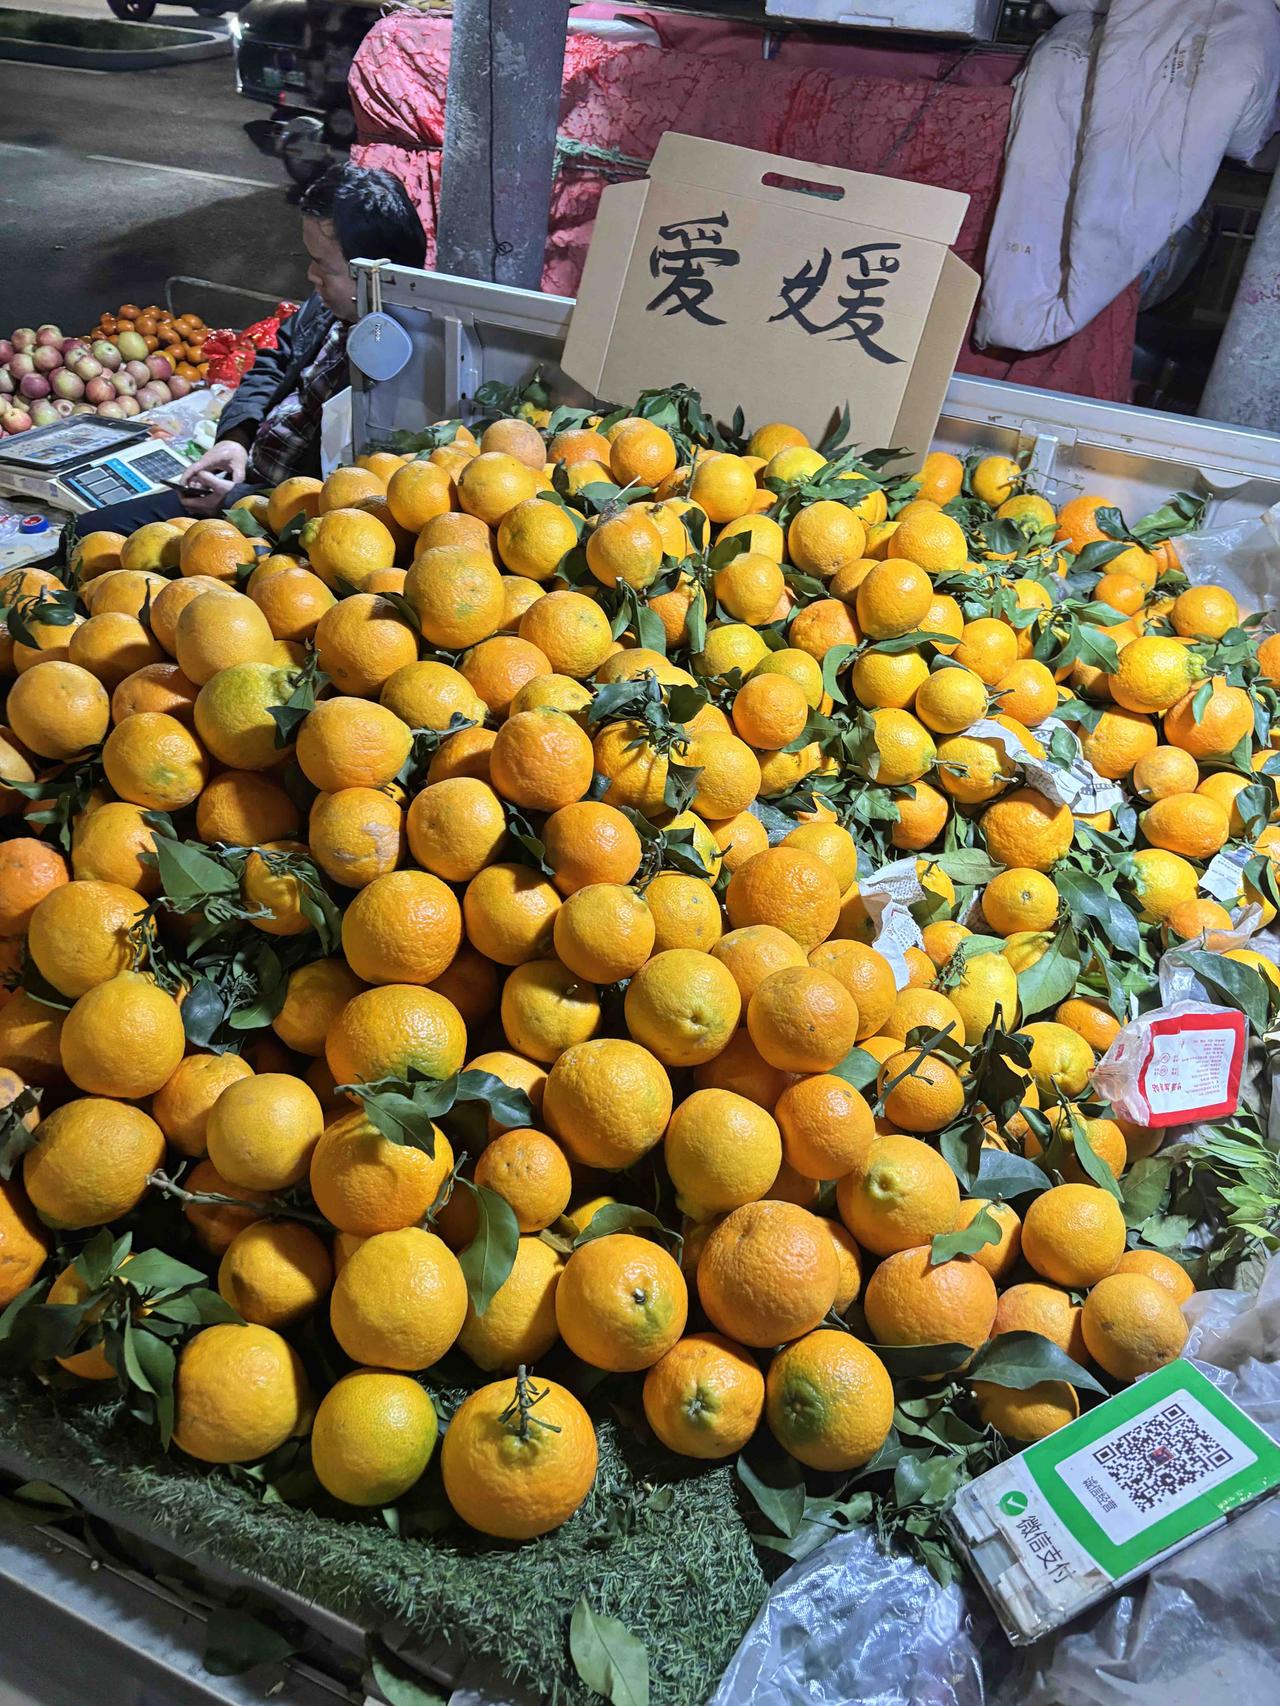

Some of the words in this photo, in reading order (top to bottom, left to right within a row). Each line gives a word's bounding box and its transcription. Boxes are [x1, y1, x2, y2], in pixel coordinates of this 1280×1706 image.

[646, 211, 907, 364] 爱媛
[1083, 1476, 1119, 1513] 诚信经营
[1016, 1515, 1077, 1584] 微信支付
